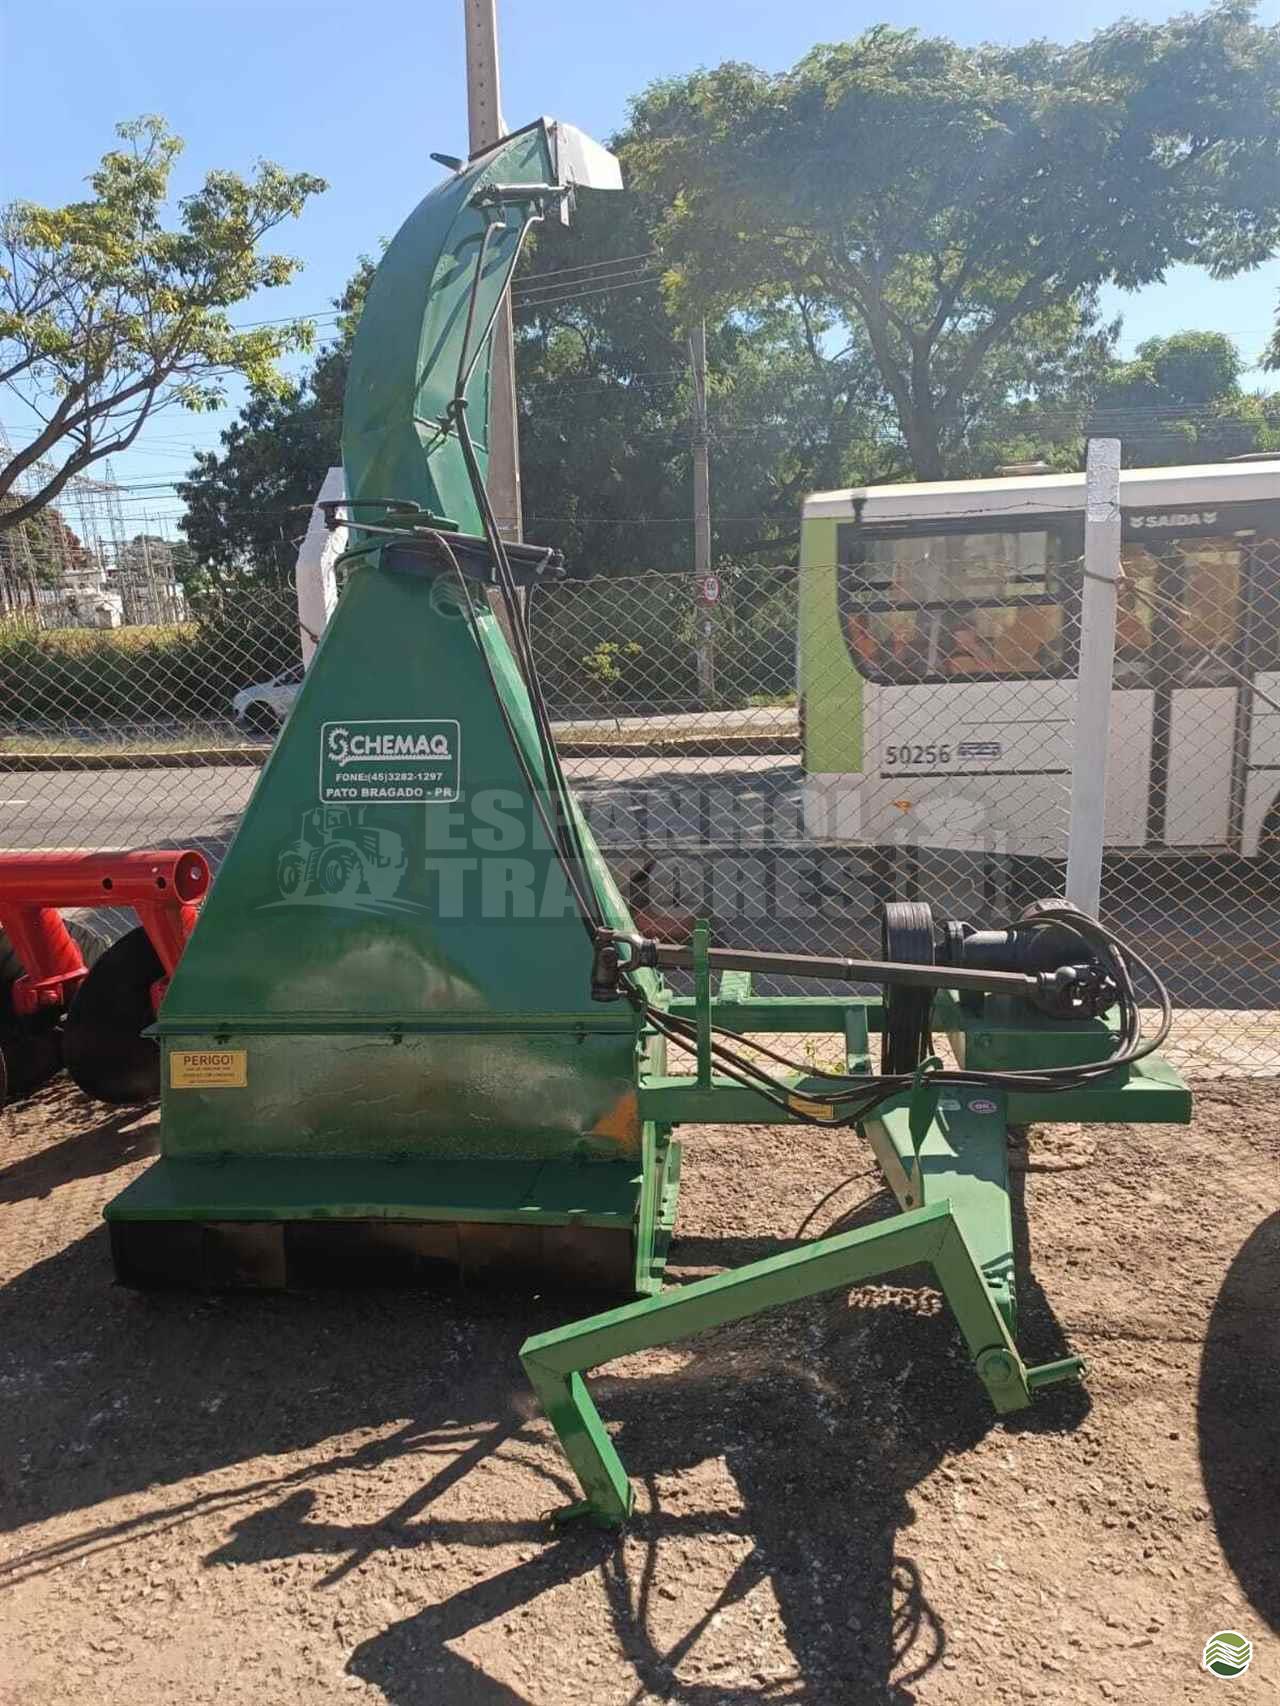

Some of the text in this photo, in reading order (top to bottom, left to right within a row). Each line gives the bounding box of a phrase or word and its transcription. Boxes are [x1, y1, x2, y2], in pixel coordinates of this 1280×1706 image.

[328, 727, 452, 767] SCHEMAQ
[885, 744, 951, 765] 50256
[326, 788, 358, 798] PATO
[361, 787, 423, 798] BRAGADO
[434, 787, 453, 797] PR
[183, 1055, 234, 1066] PERIGO!
